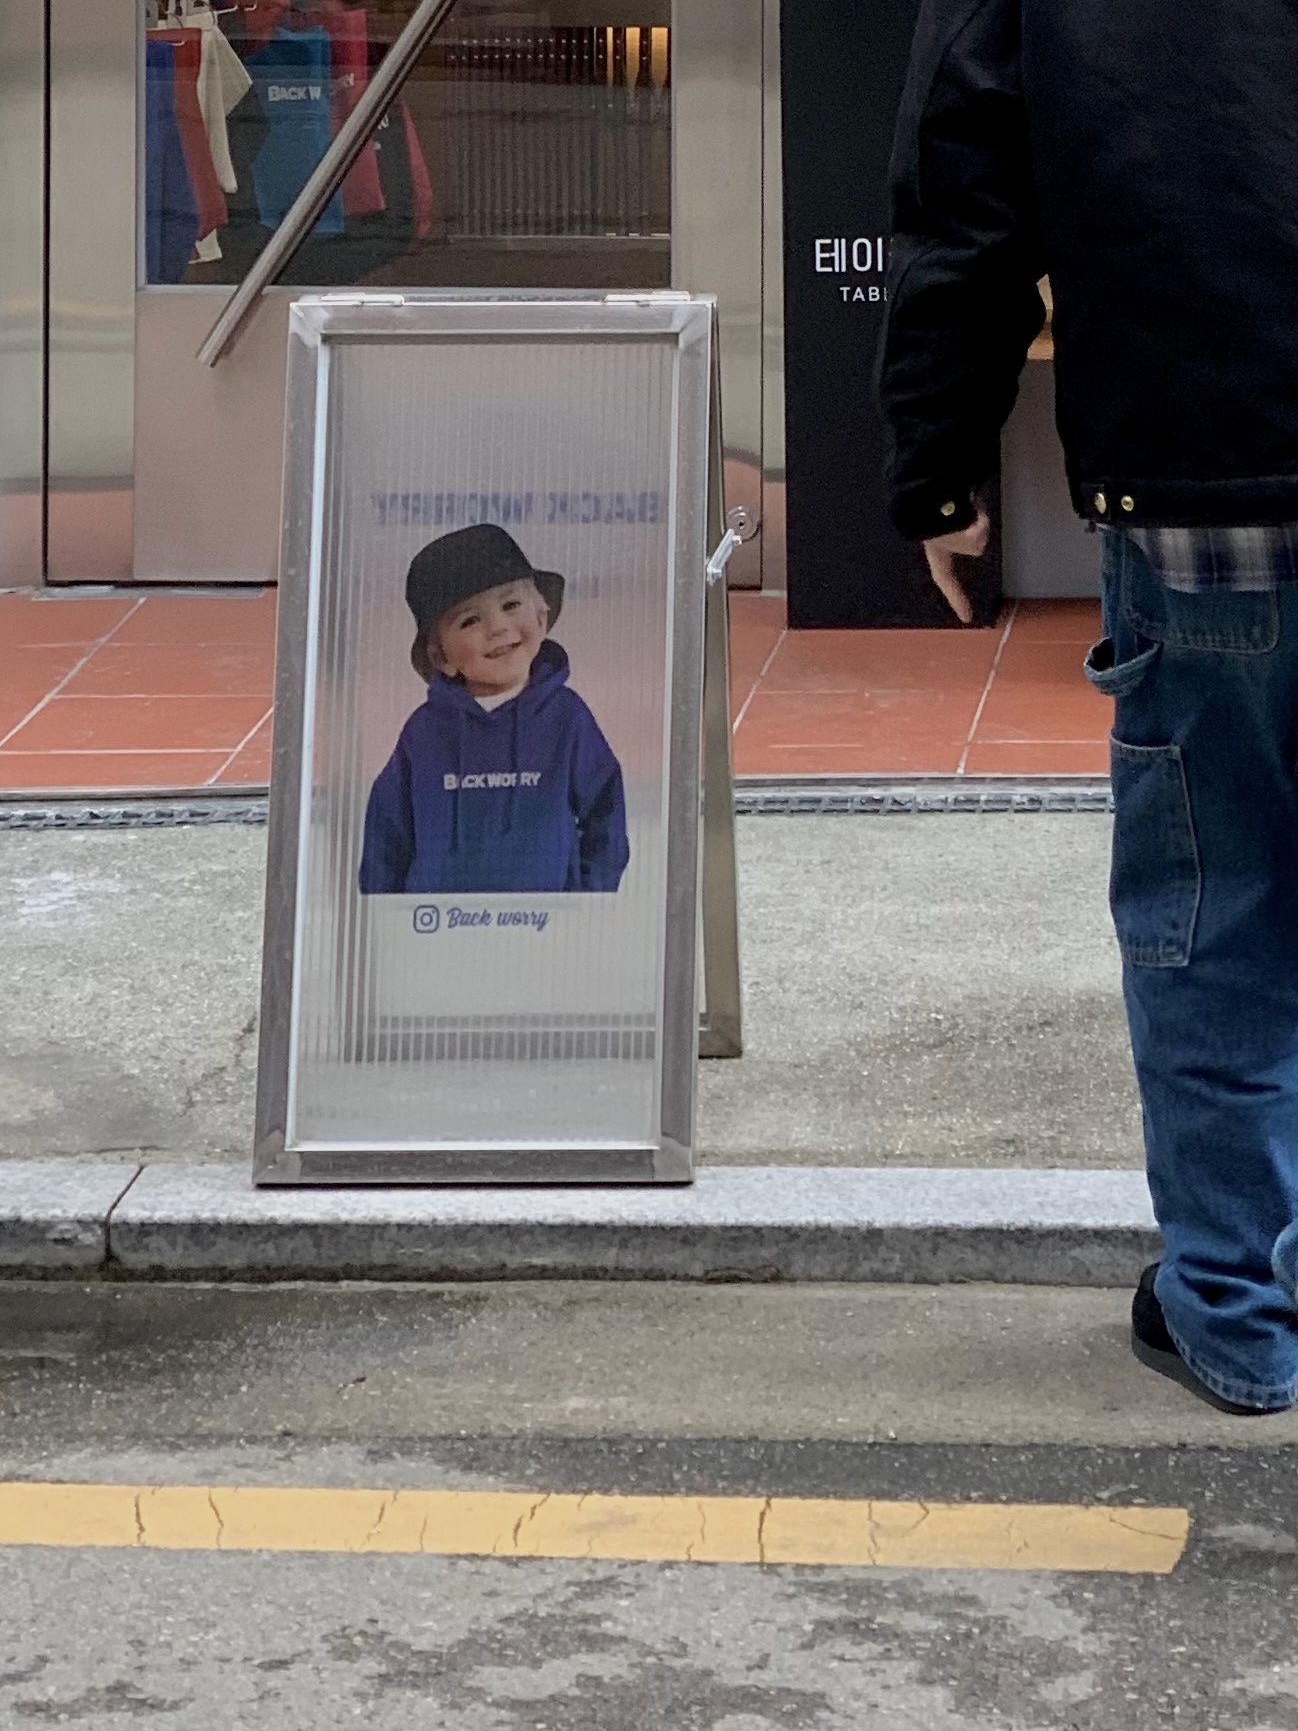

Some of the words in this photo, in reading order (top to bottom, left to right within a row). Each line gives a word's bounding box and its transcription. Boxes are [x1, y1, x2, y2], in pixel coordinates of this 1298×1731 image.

[268, 85, 306, 101] BACK
[446, 907, 492, 928] Back
[497, 911, 549, 932] worry
